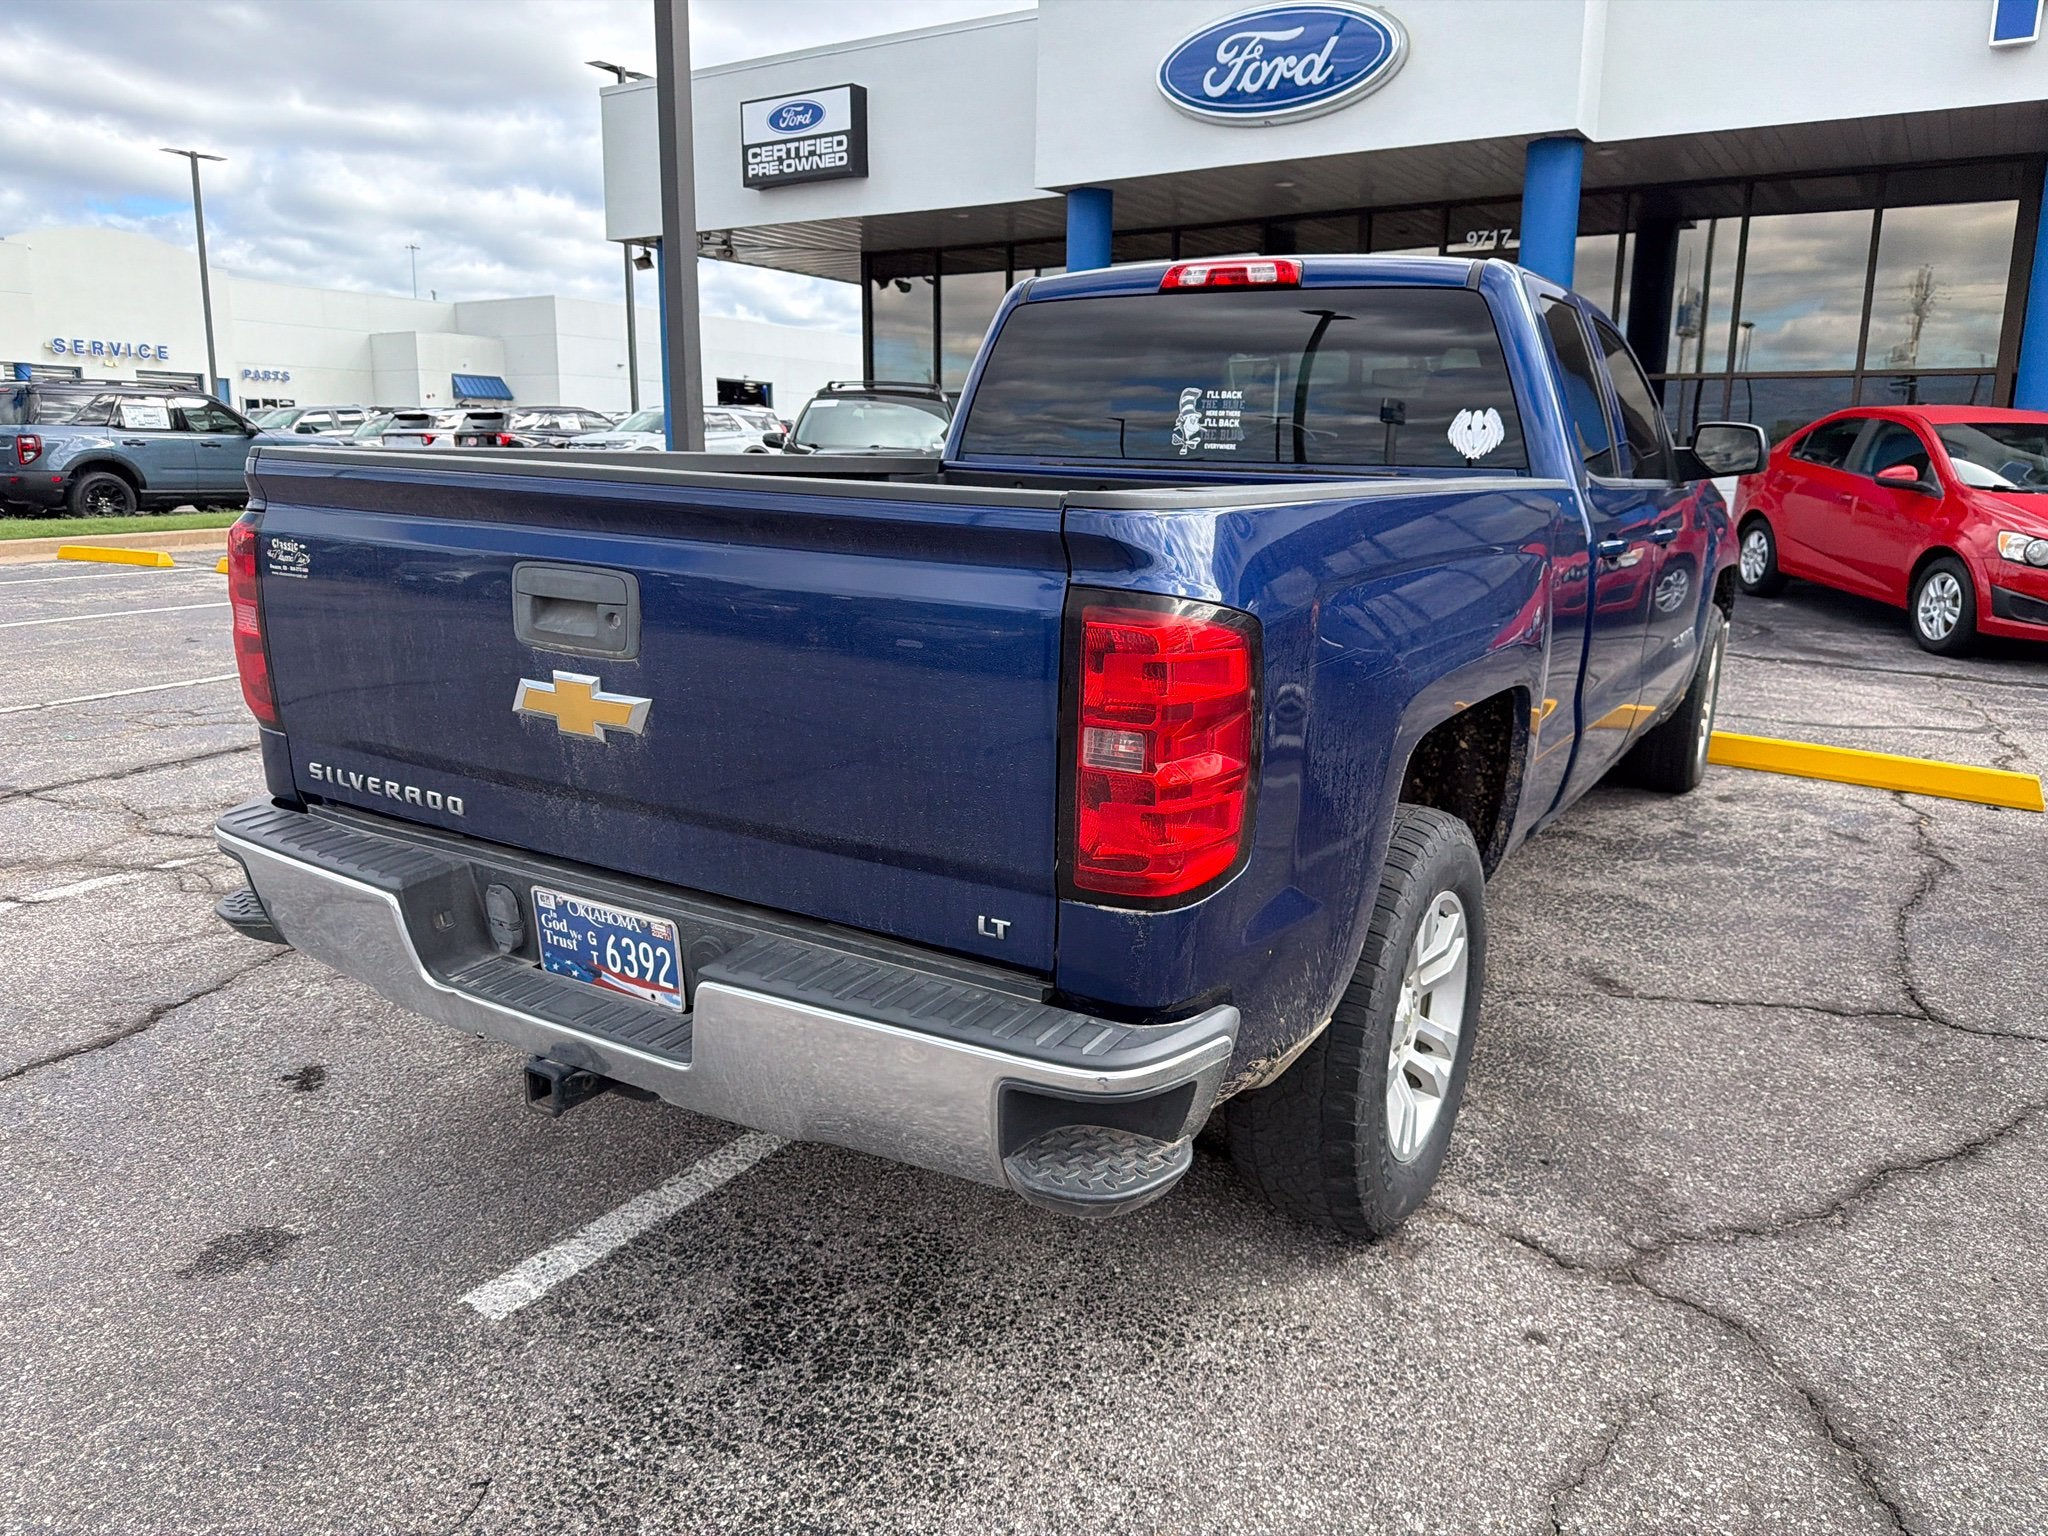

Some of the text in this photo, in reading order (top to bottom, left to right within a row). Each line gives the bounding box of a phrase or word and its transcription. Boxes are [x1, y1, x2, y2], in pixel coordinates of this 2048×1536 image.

[1202, 26, 1339, 97] Ford
[778, 105, 813, 128] Ford
[747, 134, 848, 164] CERTIFIED
[747, 152, 848, 178] PRE-OWNED
[1466, 228, 1513, 248] 9717
[52, 337, 169, 361] SERVICE
[241, 368, 291, 383] PARTS
[1201, 399, 1246, 410] THE BLUE
[1206, 390, 1242, 399] I'LL BACK
[1204, 418, 1240, 427] I'LL BACK
[1200, 429, 1217, 440] THE
[271, 538, 299, 553] Classic
[308, 762, 465, 817] SILVERADO
[549, 909, 558, 919] In
[566, 900, 642, 933] OKLAHOMA
[541, 913, 583, 942] God We
[977, 915, 1011, 940] LT
[543, 929, 578, 951] Trust
[605, 934, 674, 989] 6392
